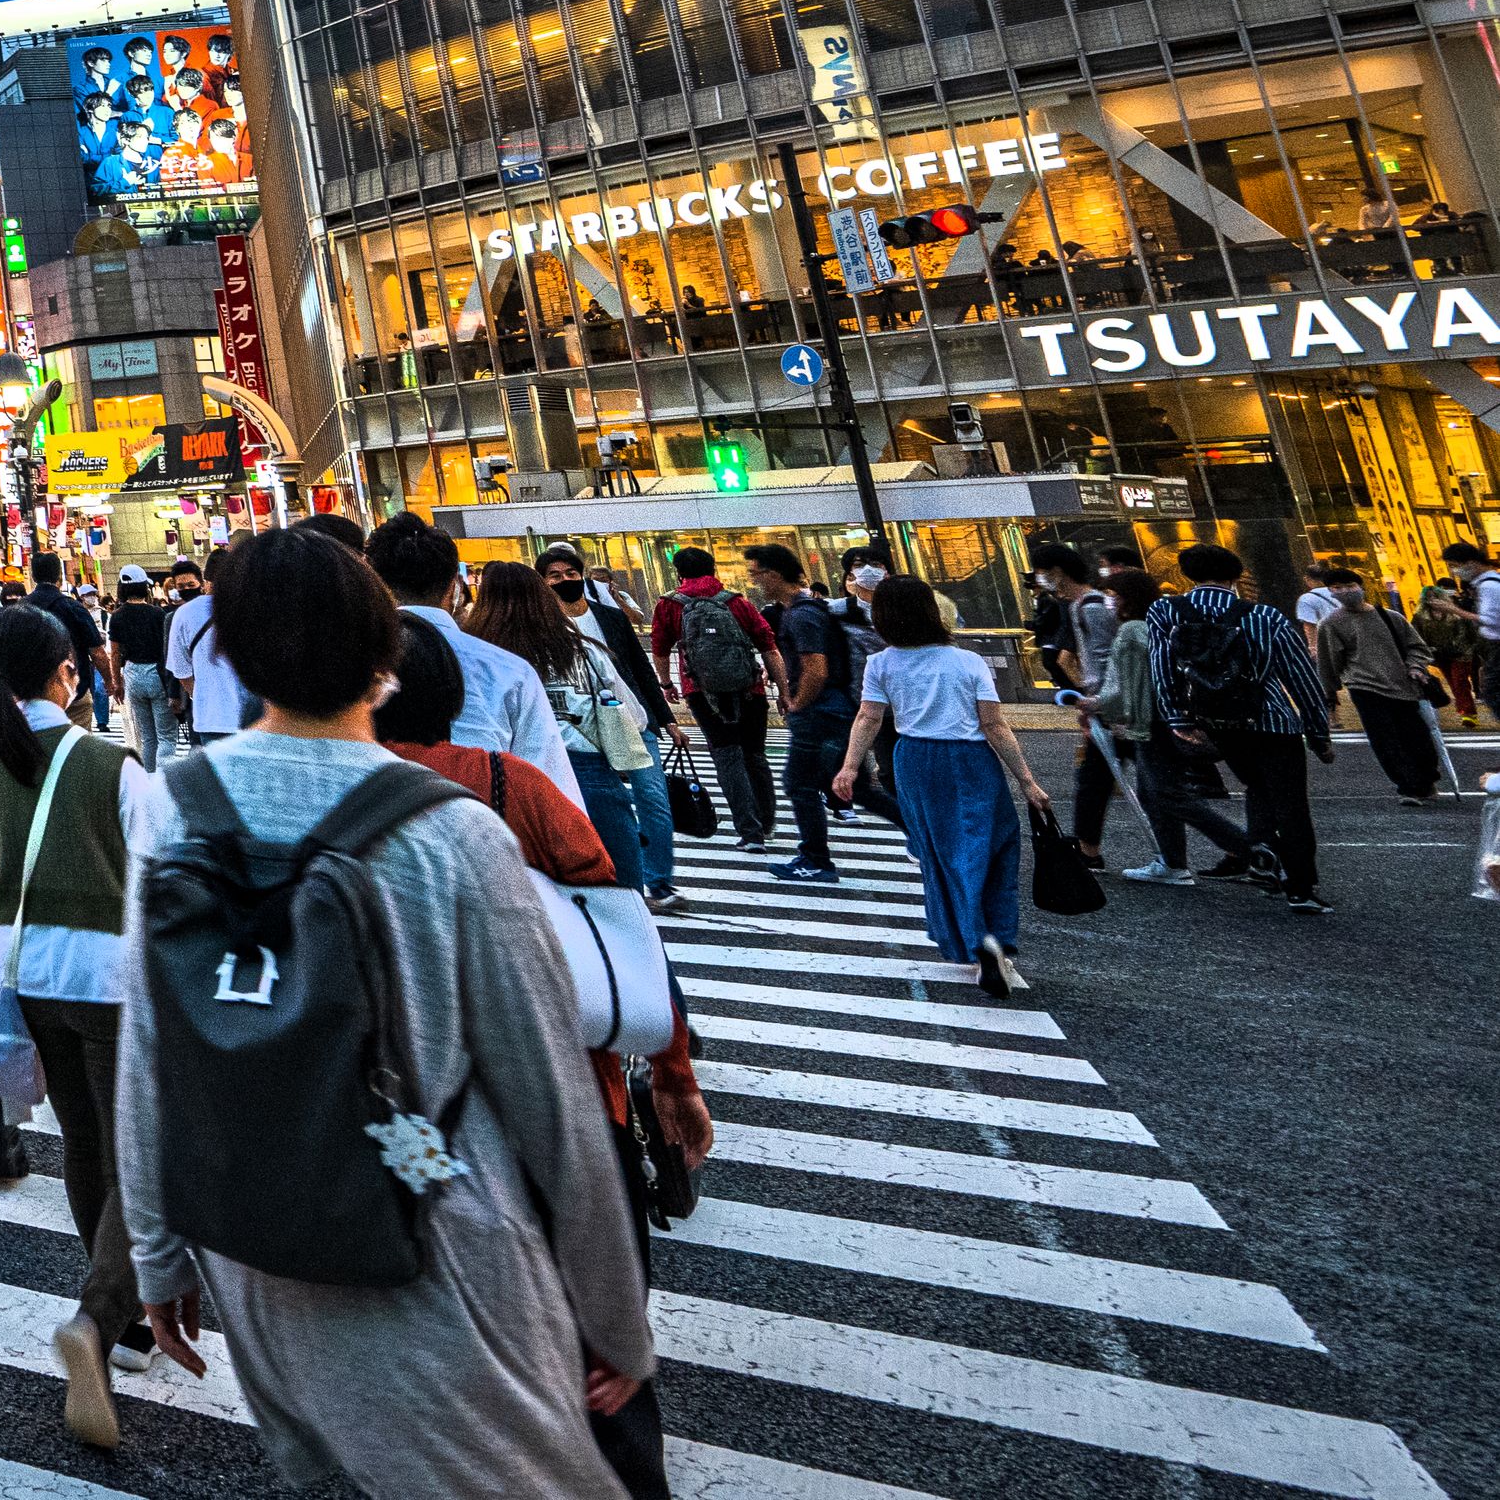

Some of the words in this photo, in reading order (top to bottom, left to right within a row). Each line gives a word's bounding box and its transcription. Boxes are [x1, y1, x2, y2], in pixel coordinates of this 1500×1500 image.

[487, 178, 784, 260] STARBUCKS
[817, 133, 1066, 202] COFFEE
[840, 215, 869, 284] 渋谷駅前
[862, 212, 889, 279] スクランブル式
[223, 249, 257, 350] カラオケ
[1020, 288, 1500, 379] TSUTAYA
[98, 359, 119, 371] My
[125, 356, 151, 367] Time
